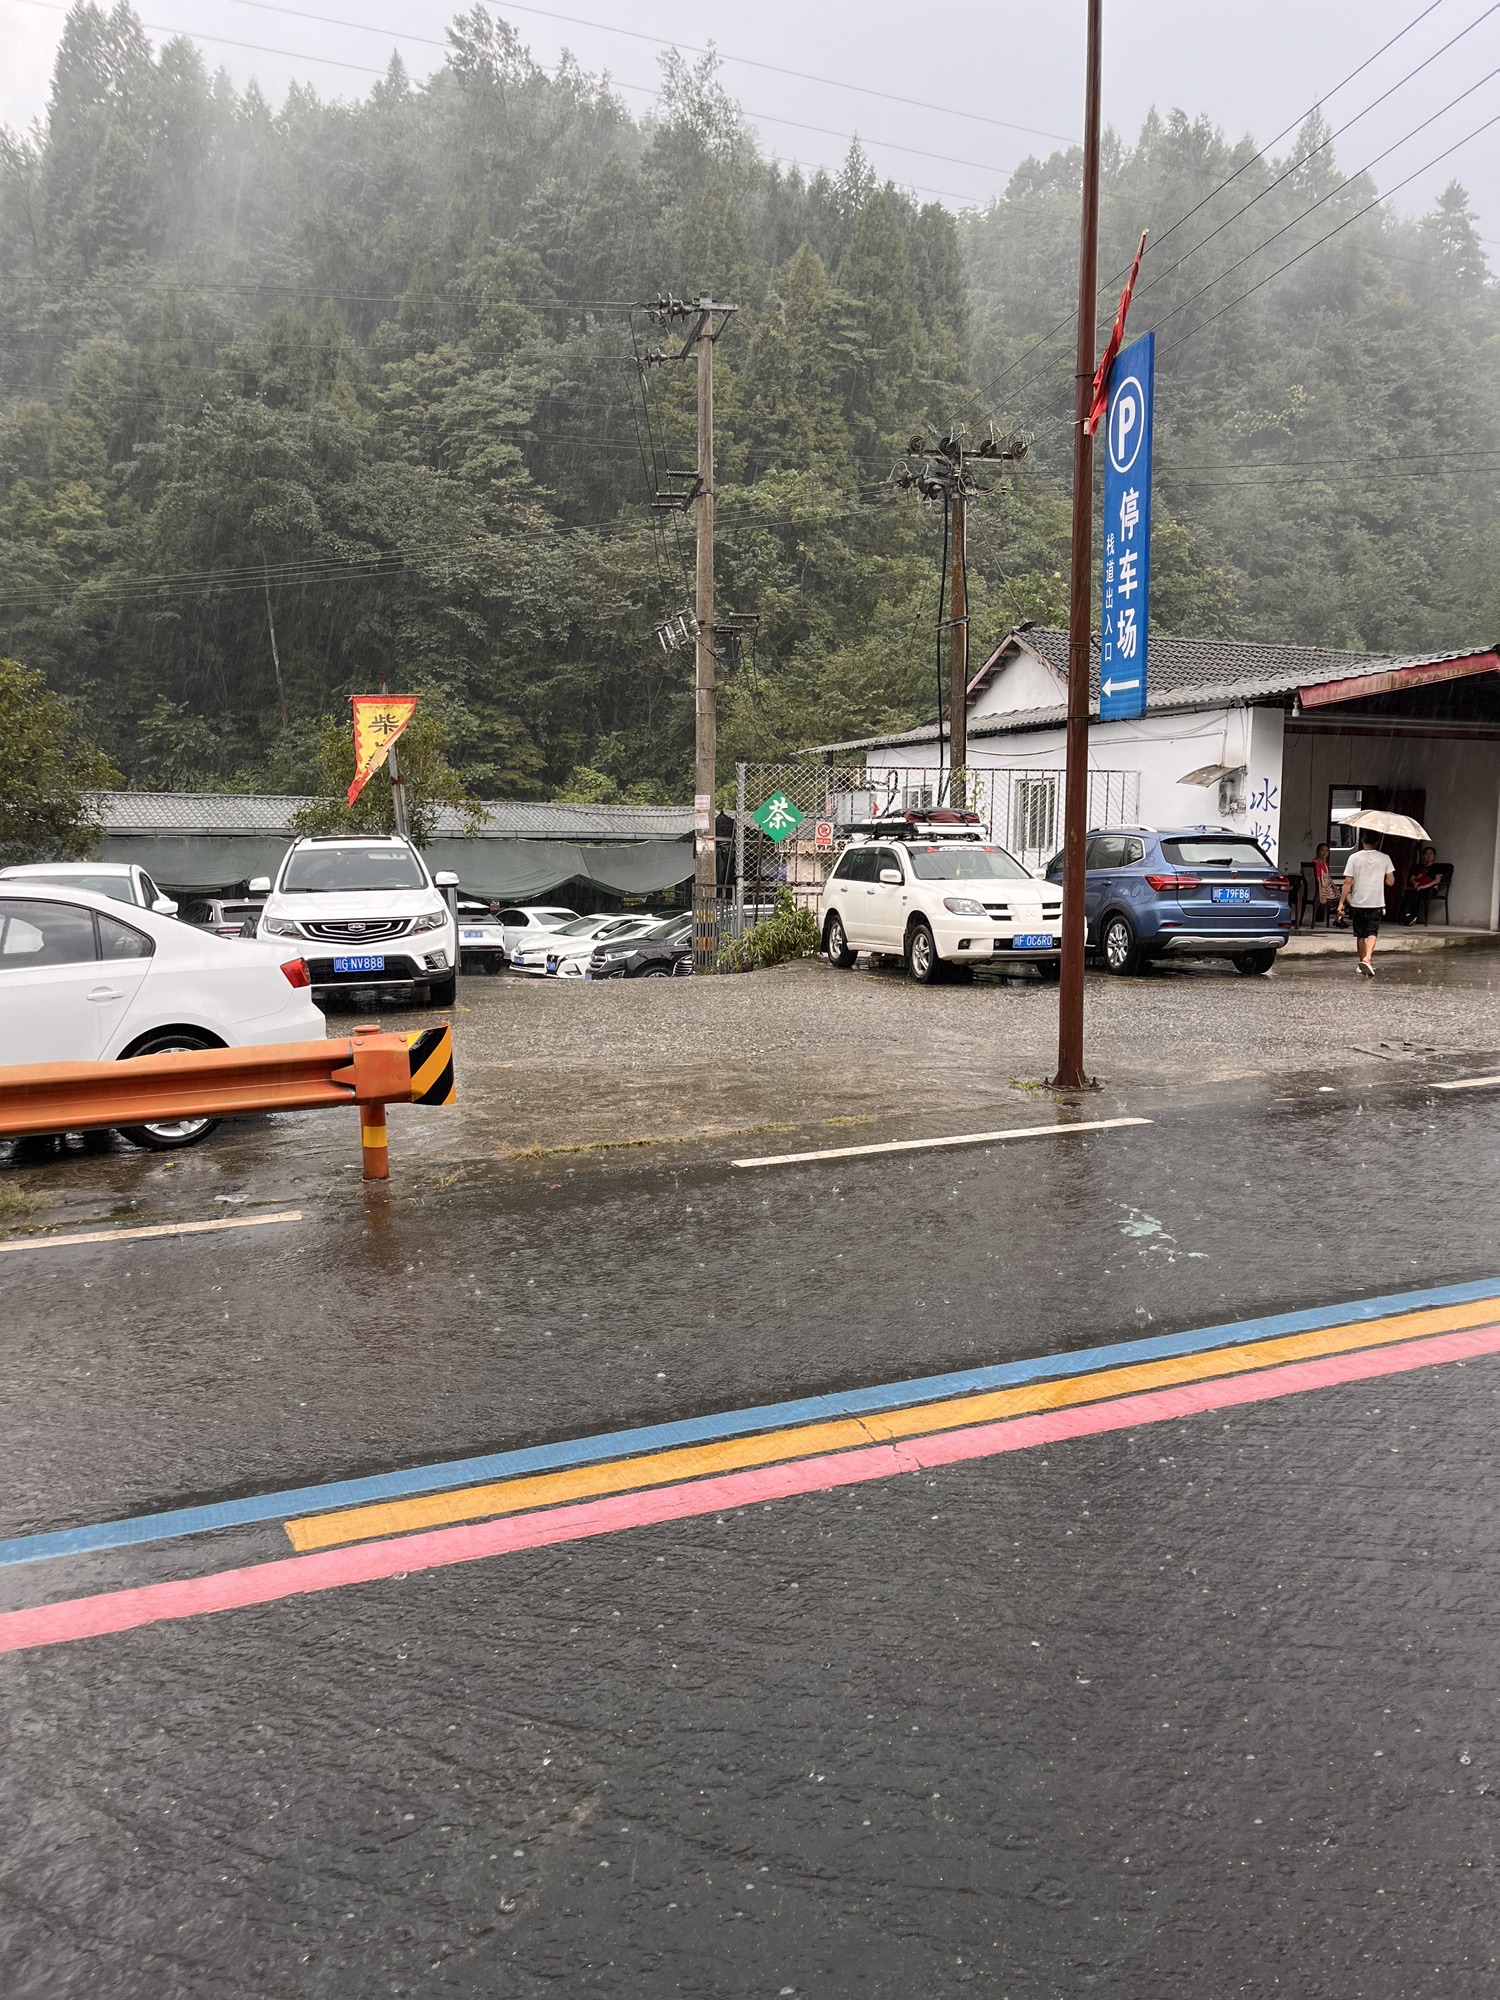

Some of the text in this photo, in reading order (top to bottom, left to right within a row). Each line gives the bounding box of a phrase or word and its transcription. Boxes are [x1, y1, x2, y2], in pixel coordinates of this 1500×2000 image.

[1118, 396, 1136, 461] P
[1104, 532, 1115, 662] 栈道出入口
[1117, 486, 1140, 659] 停车场
[762, 796, 797, 830] 茶
[1249, 777, 1278, 853] 冰粉
